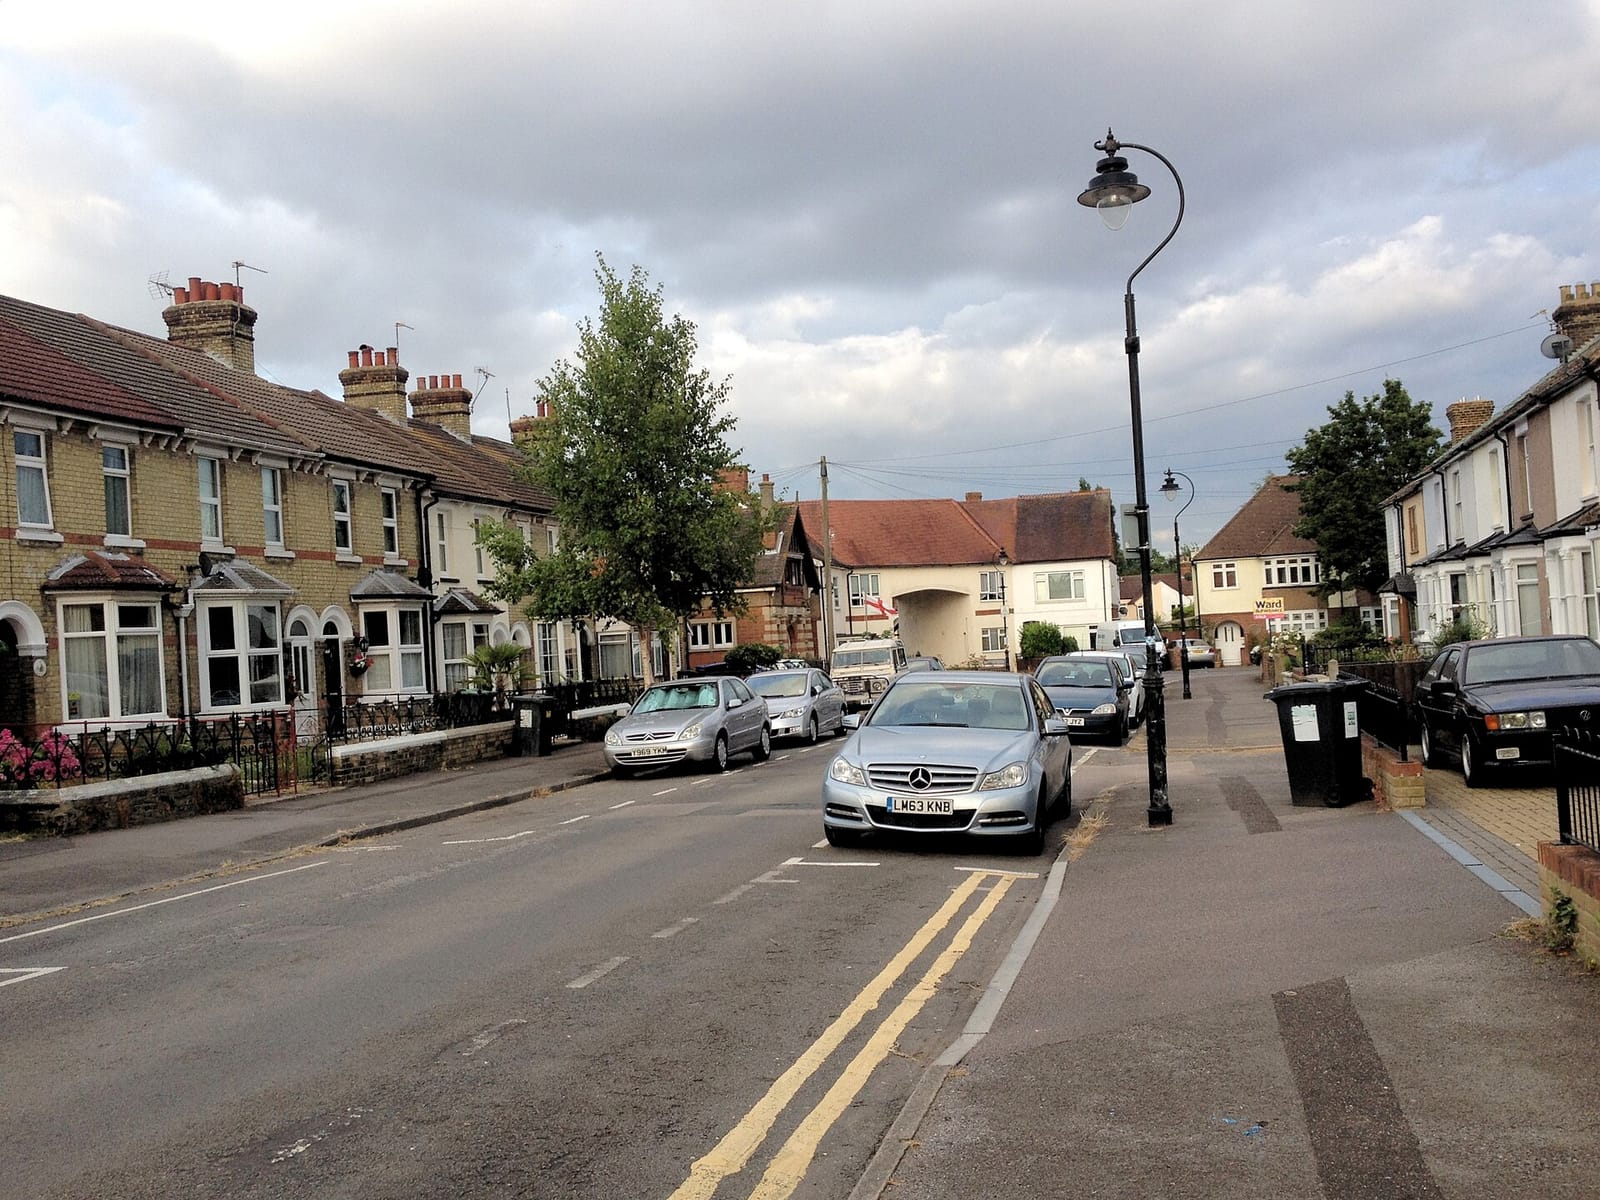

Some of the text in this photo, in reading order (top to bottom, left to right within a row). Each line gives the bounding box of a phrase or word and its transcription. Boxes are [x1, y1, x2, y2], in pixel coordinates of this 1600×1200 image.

[1255, 599, 1282, 608] Ward
[894, 799, 950, 813] LM63 KNB
